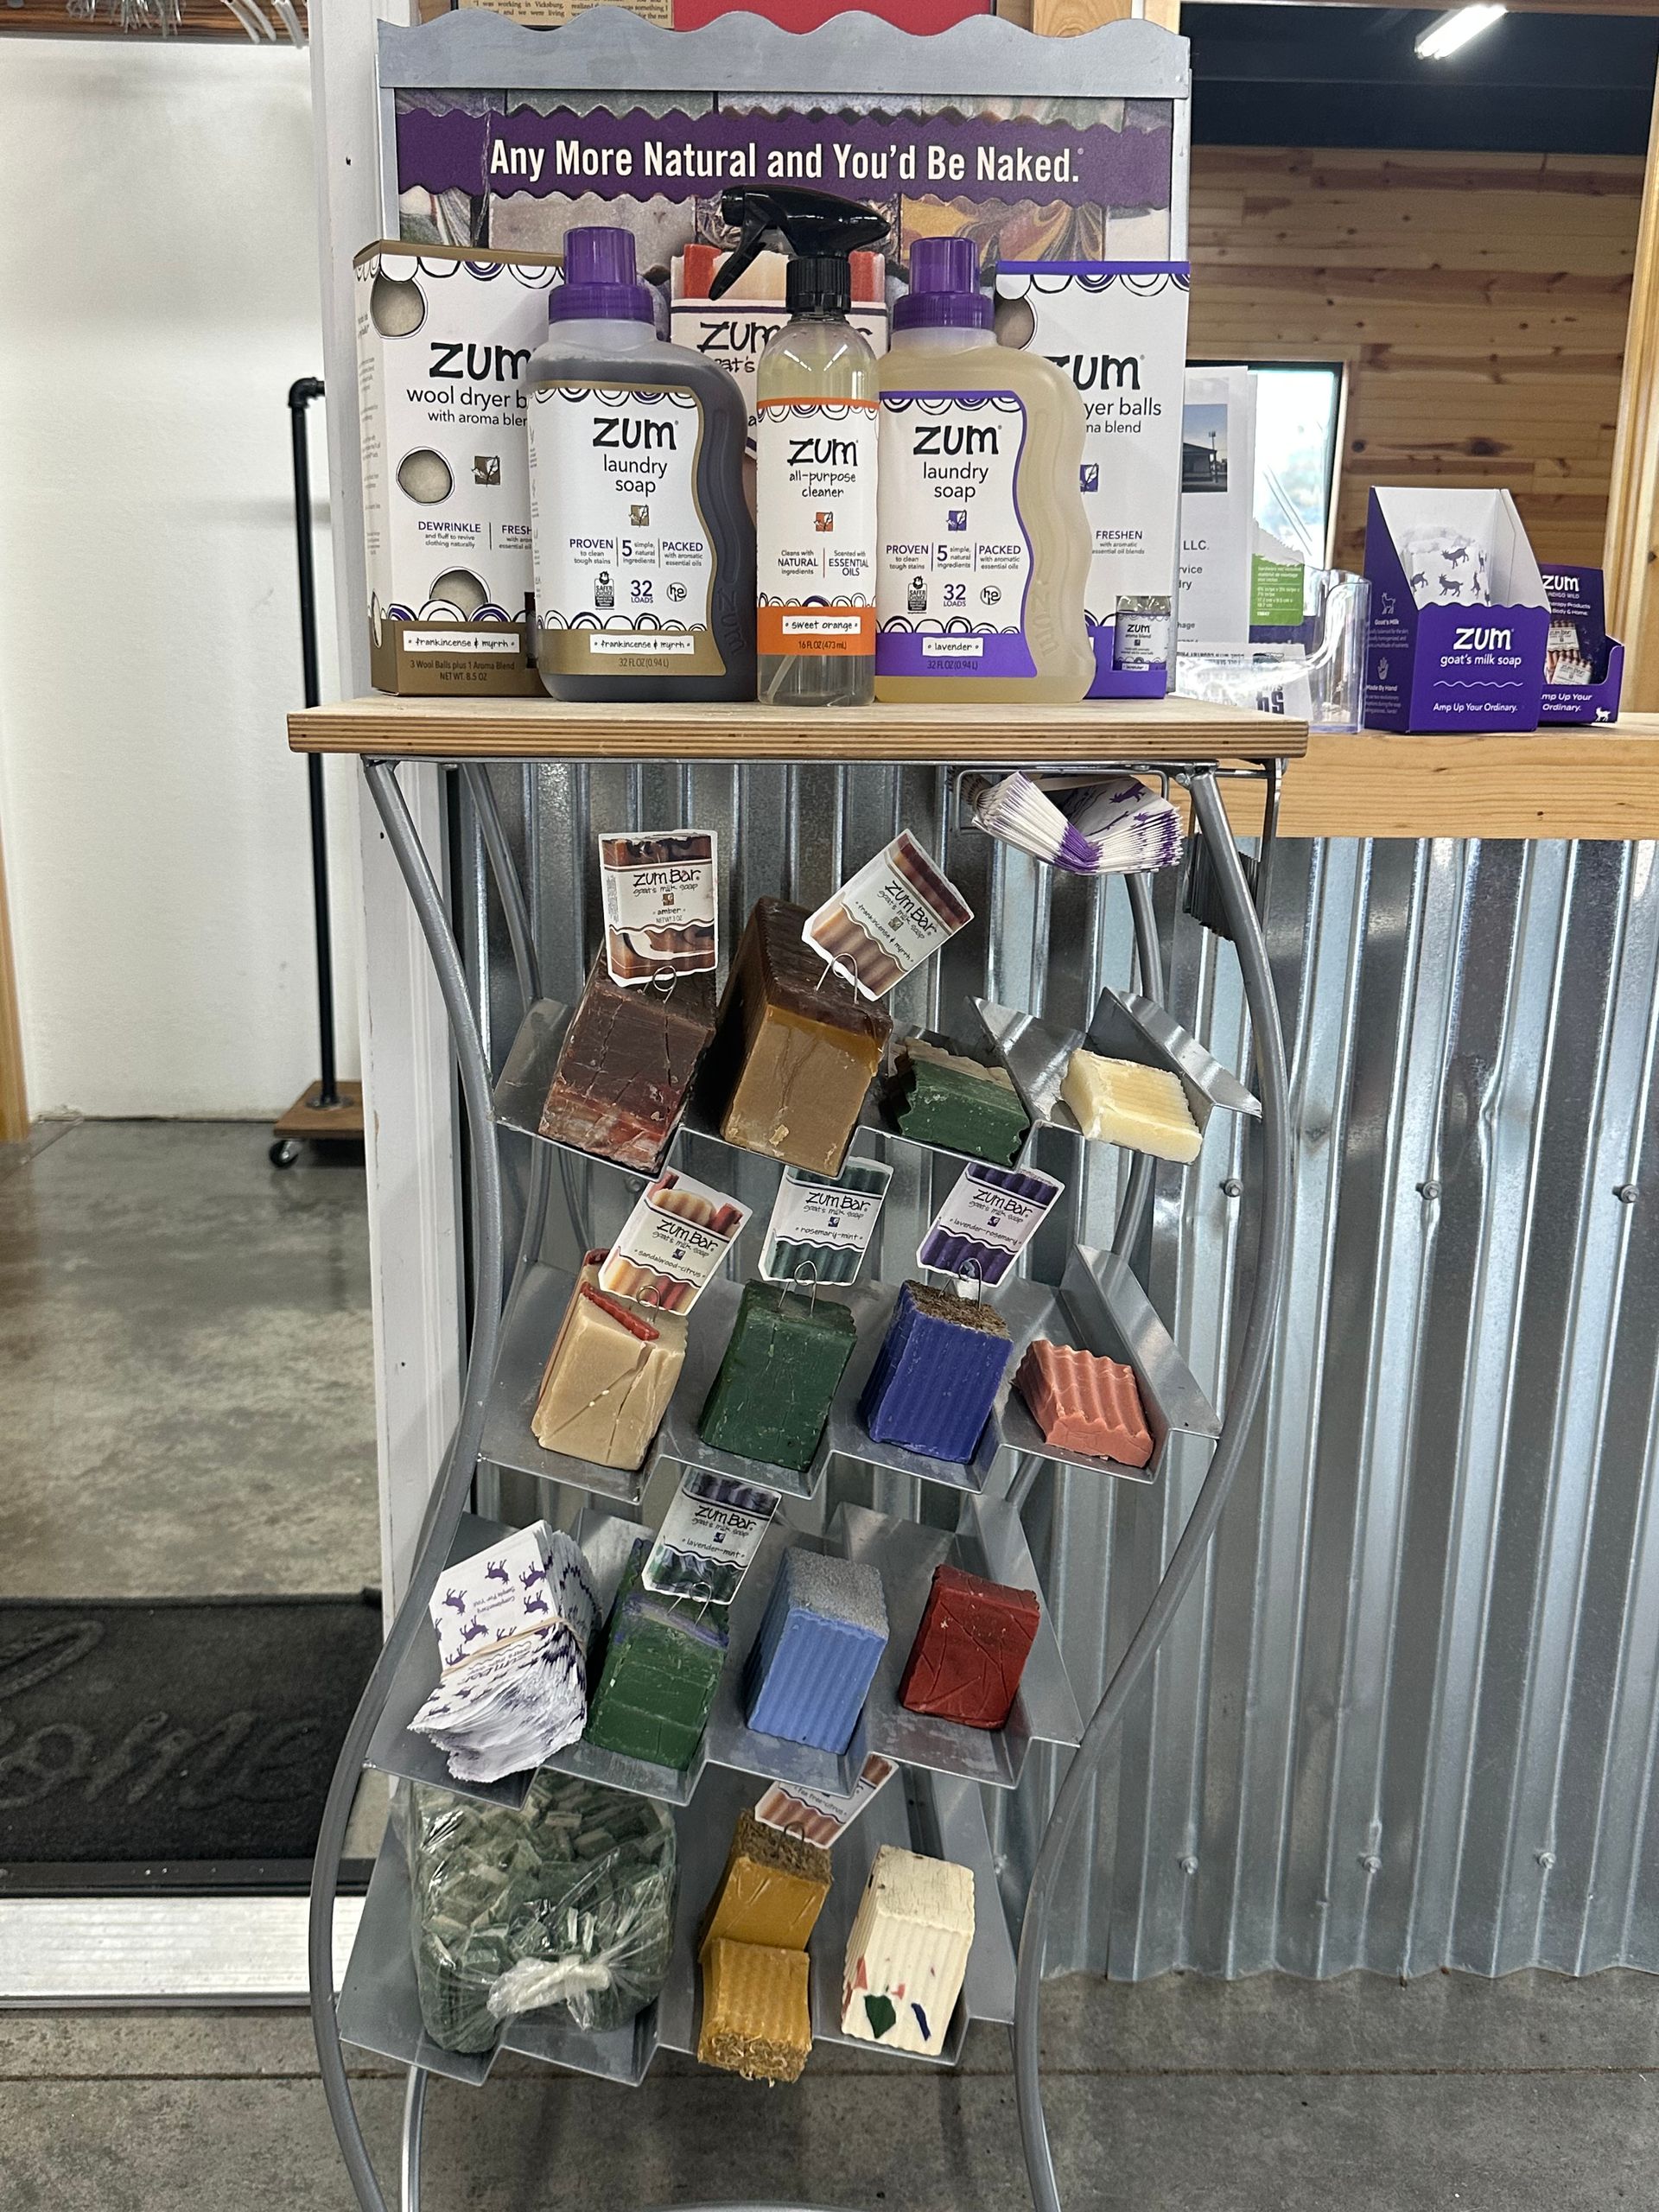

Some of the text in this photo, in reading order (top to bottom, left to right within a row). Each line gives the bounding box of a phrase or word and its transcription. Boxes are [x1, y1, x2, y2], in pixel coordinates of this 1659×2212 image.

[490, 139, 1079, 182] Any More Natural and You'd Be Naked.
[406, 385, 454, 404] wool
[460, 386, 511, 411] dryer
[1119, 397, 1161, 416] balls
[428, 410, 499, 425] with aroma
[593, 416, 677, 450] zum
[1105, 421, 1141, 433] blend
[912, 425, 999, 455] zum
[787, 438, 858, 467] zum
[603, 454, 668, 479] laundry
[923, 461, 988, 484] laundry
[790, 470, 856, 486] all-purpose
[615, 480, 656, 498] soap
[802, 486, 844, 498] cleaner
[934, 485, 976, 503] soap
[418, 521, 481, 533] DEWRINKLE
[1096, 531, 1142, 539] FRESHEN
[569, 538, 613, 550] PROVEN
[621, 539, 632, 556] 5
[662, 541, 703, 552] PACKED
[886, 545, 929, 555] PROVEN
[979, 545, 1021, 555] PACKED
[937, 544, 948, 562] 5
[778, 558, 818, 567] NATURAL
[829, 558, 869, 568] ESSENTIAL
[842, 568, 860, 576] OILS
[631, 580, 653, 597] 32
[944, 584, 966, 601] 32
[791, 620, 852, 632] sweet orange
[416, 638, 472, 647] frankincense
[481, 639, 509, 649] myrrh
[601, 639, 652, 648] frankincense
[660, 641, 684, 650] myrrh
[1453, 628, 1512, 650] zum
[410, 660, 415, 669] 3
[416, 660, 434, 669] Wool
[435, 660, 450, 669] Balls
[452, 661, 467, 671] plus
[618, 658, 627, 667] 32
[1440, 654, 1522, 668] goat's milk soap
[467, 672, 477, 681] 8.5
[1433, 703, 1518, 715] Amp Up Your Ordinary.
[859, 904, 890, 938] frankincense
[894, 941, 911, 960] myrrh
[800, 1227, 858, 1241] rosemary-mint
[954, 1218, 1018, 1246] lavender-rosemary
[638, 1249, 701, 1279] sandalwood-citrus
[687, 1538, 741, 1558] lavender-mint
